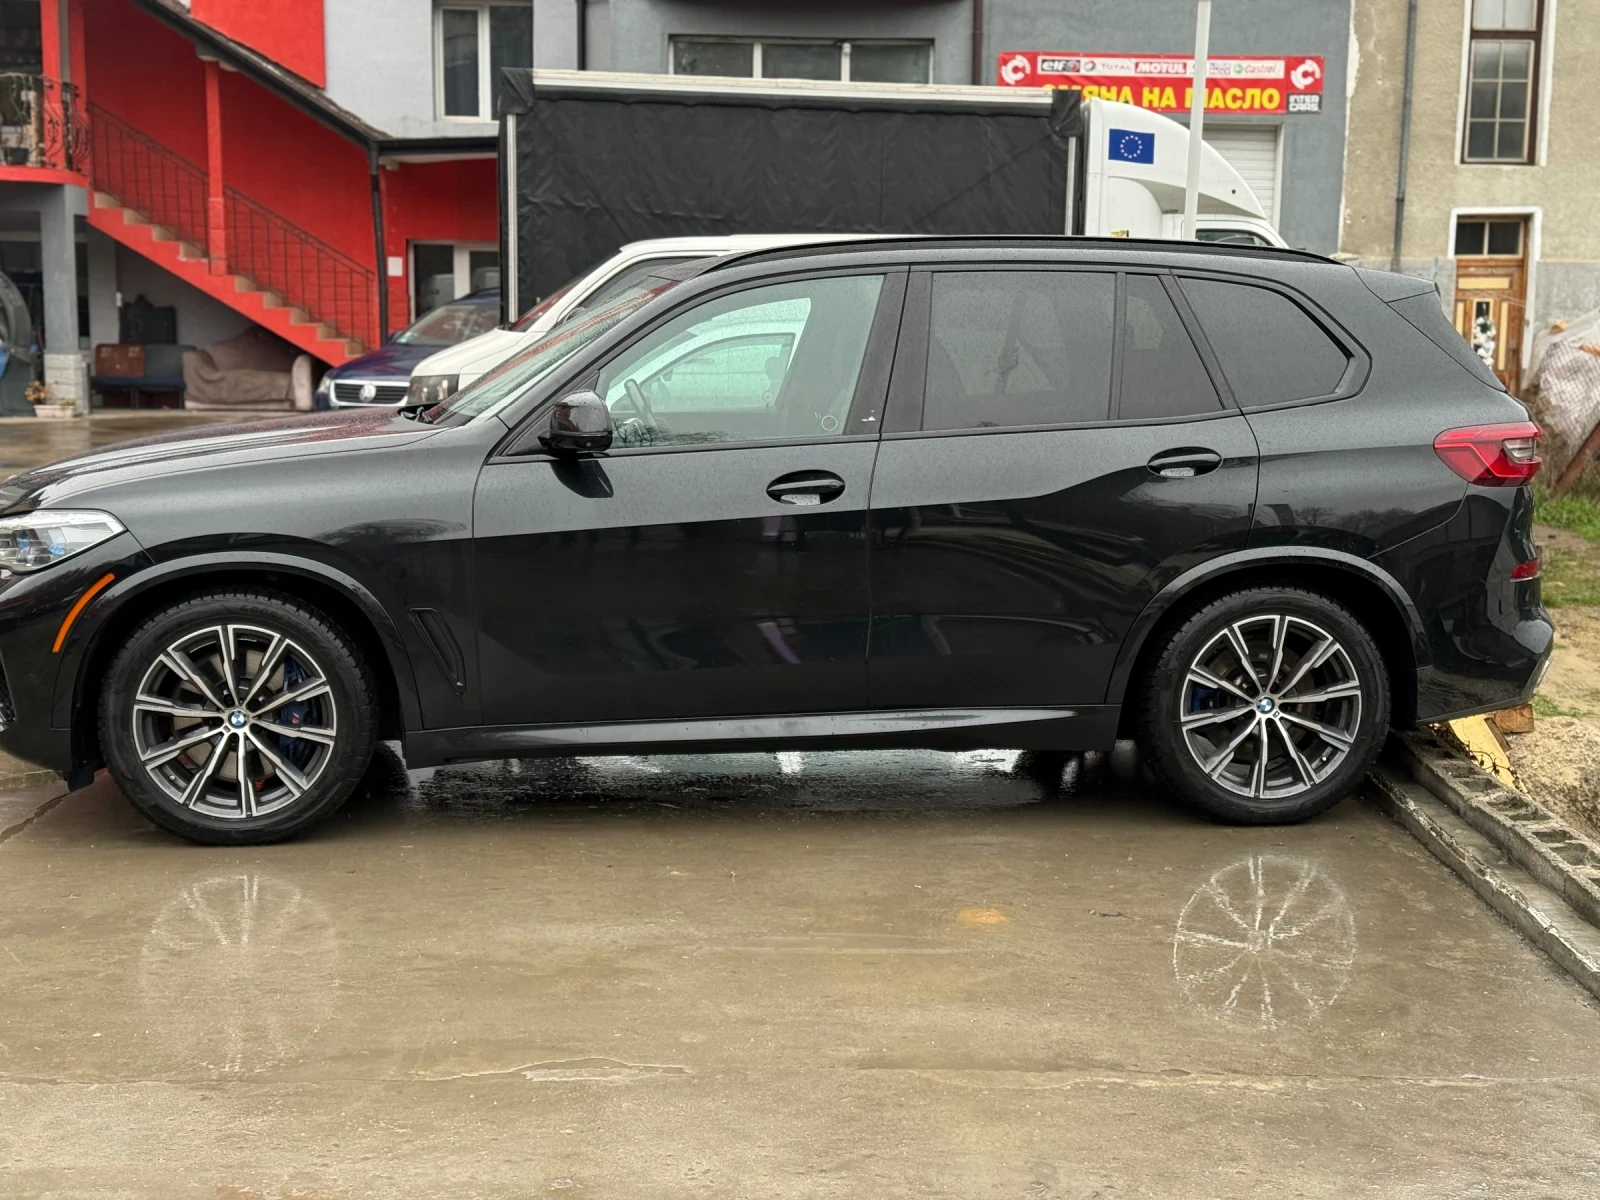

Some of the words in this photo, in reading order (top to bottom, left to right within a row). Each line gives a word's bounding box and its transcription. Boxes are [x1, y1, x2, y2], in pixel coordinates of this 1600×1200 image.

[1042, 60, 1063, 71] elf
[1101, 62, 1132, 71] TOTAL
[1136, 62, 1185, 74] MOTUL
[1142, 86, 1177, 108] НА
